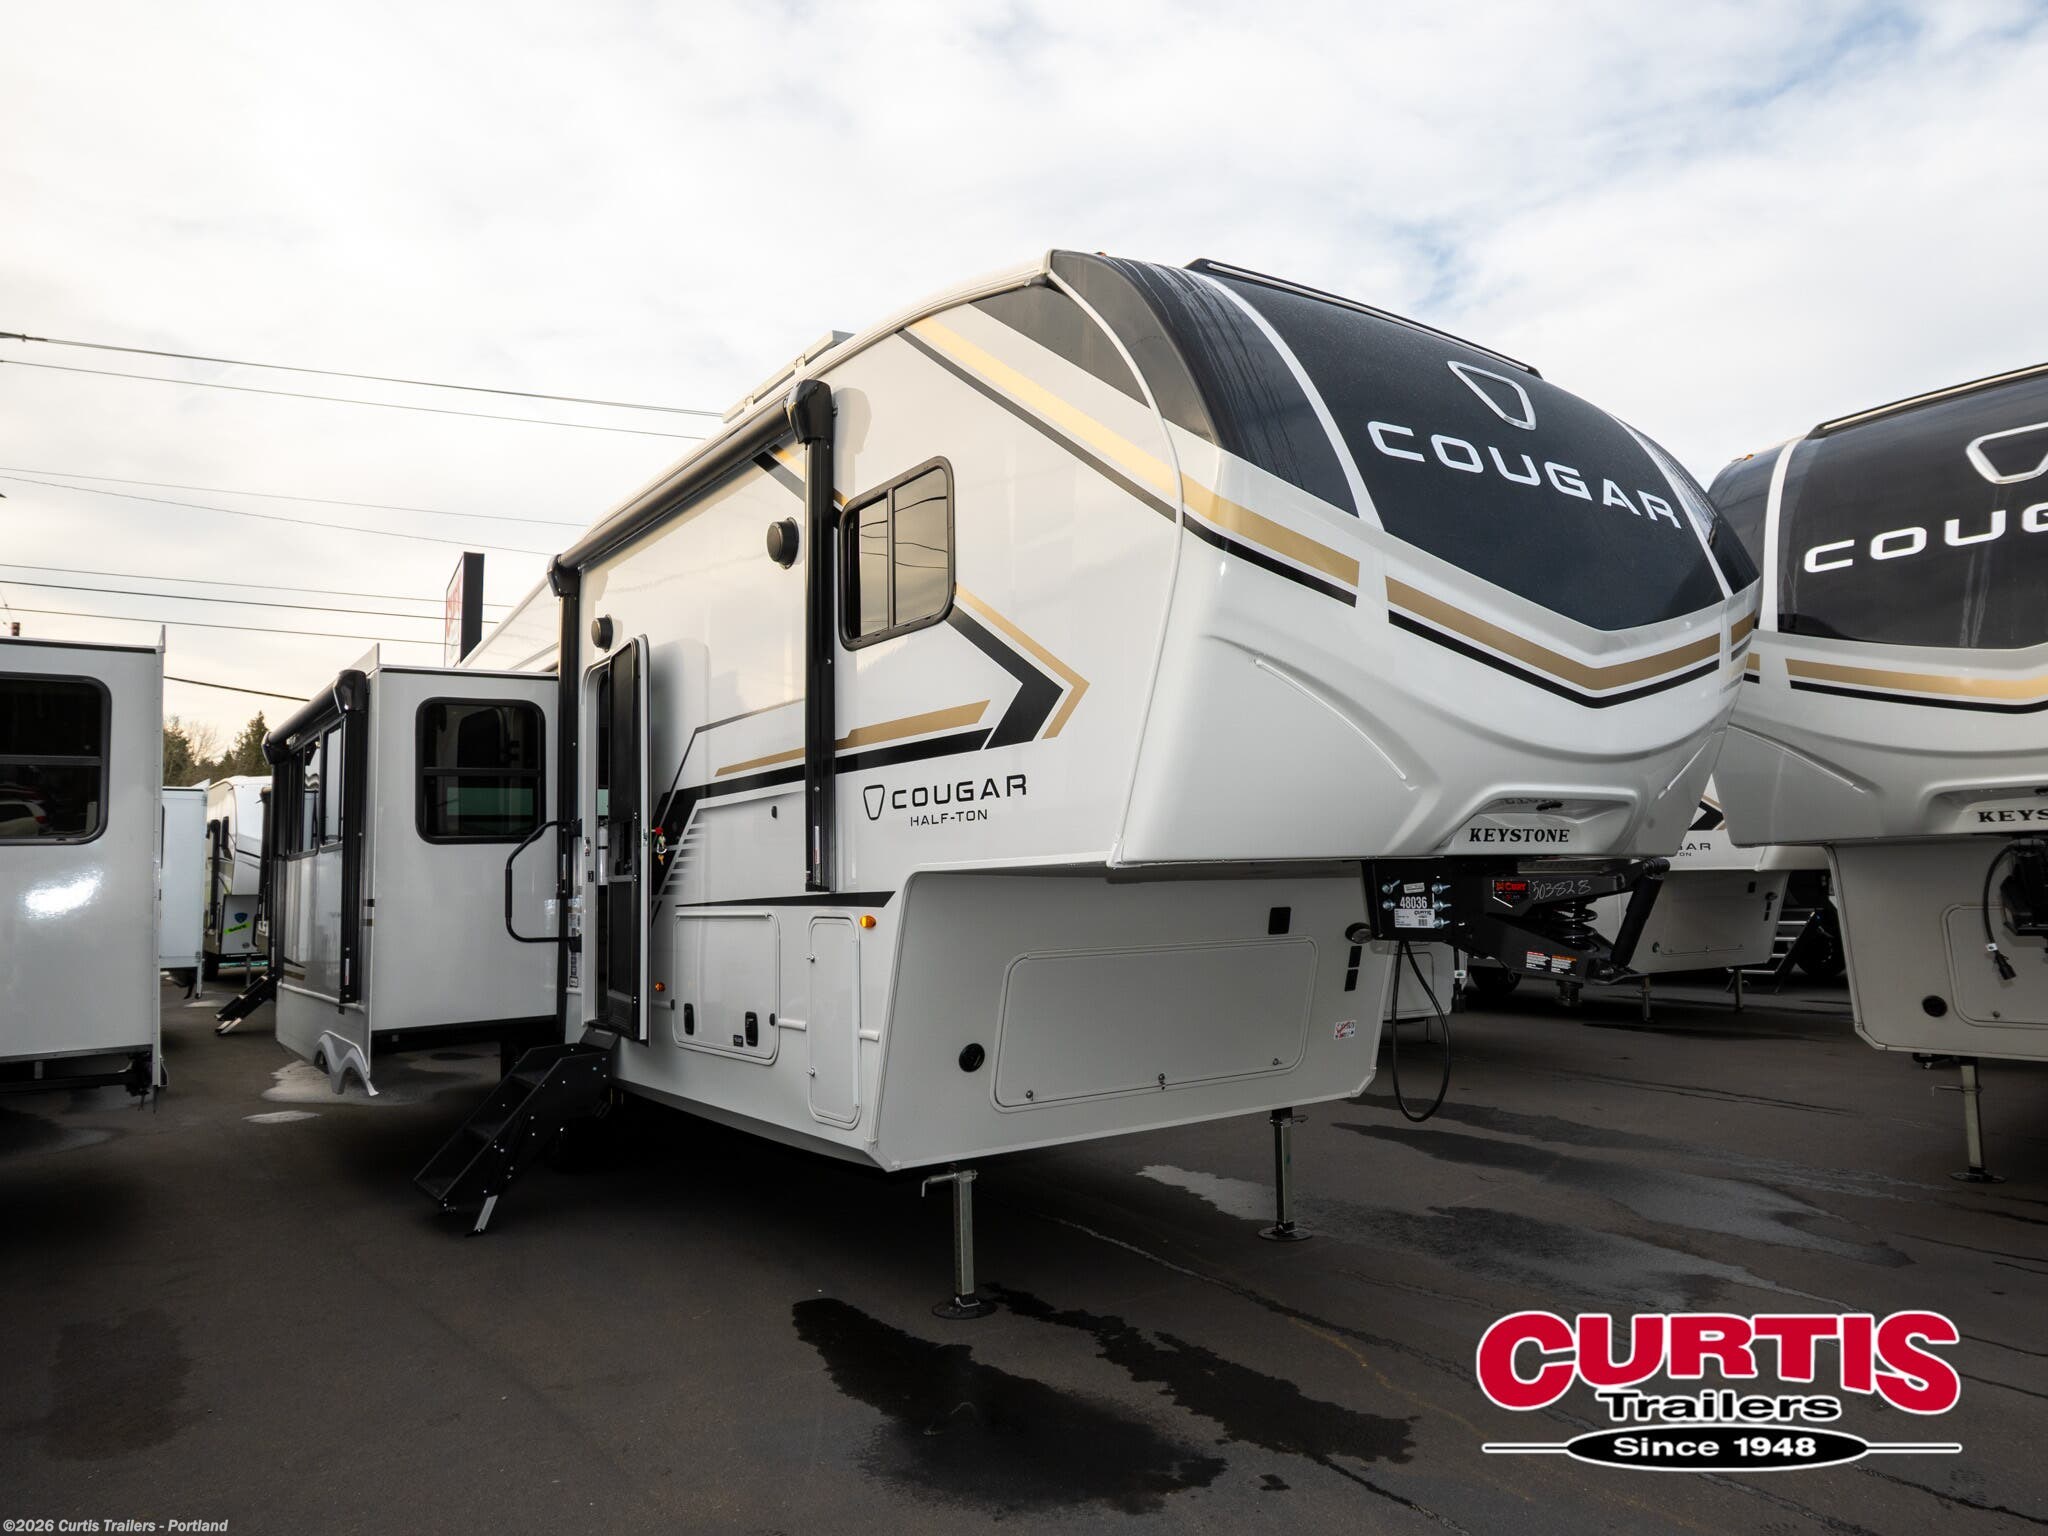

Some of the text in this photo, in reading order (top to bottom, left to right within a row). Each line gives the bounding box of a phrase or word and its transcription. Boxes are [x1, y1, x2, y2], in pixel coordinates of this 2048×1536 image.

[1367, 421, 1682, 529] COUGAR
[891, 774, 1027, 809] COUGAR
[910, 809, 988, 827] HALF-TON
[1469, 828, 1570, 843] KEYSTONE
[1400, 896, 1428, 909] 48036
